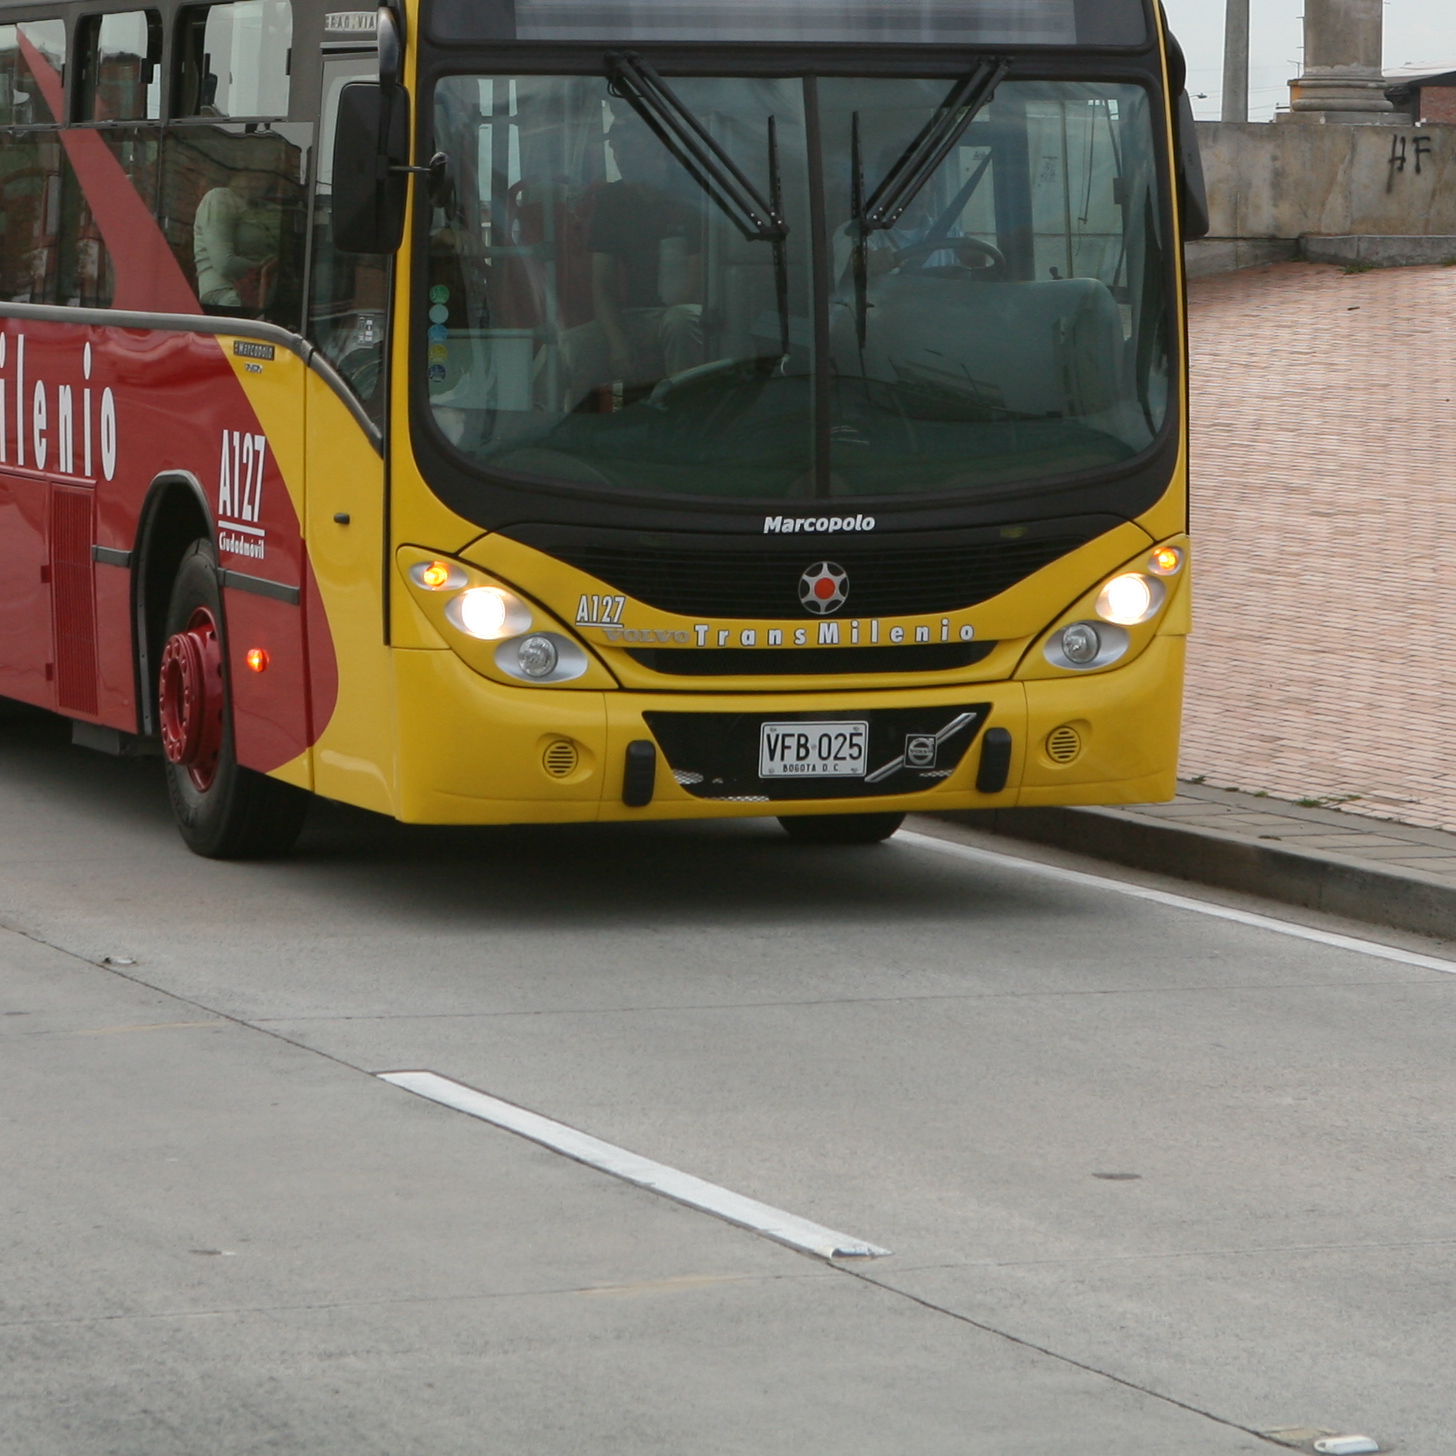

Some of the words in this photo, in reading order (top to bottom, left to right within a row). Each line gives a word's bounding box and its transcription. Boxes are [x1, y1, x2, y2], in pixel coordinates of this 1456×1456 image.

[218, 429, 266, 523] A127
[763, 514, 875, 534] Marcopolo
[576, 594, 626, 624] A127
[602, 628, 690, 643] VOLVO
[694, 618, 975, 647] TransMilenio
[766, 733, 810, 762] VFB
[818, 733, 864, 762] 025
[782, 763, 817, 773] BOGOTA
